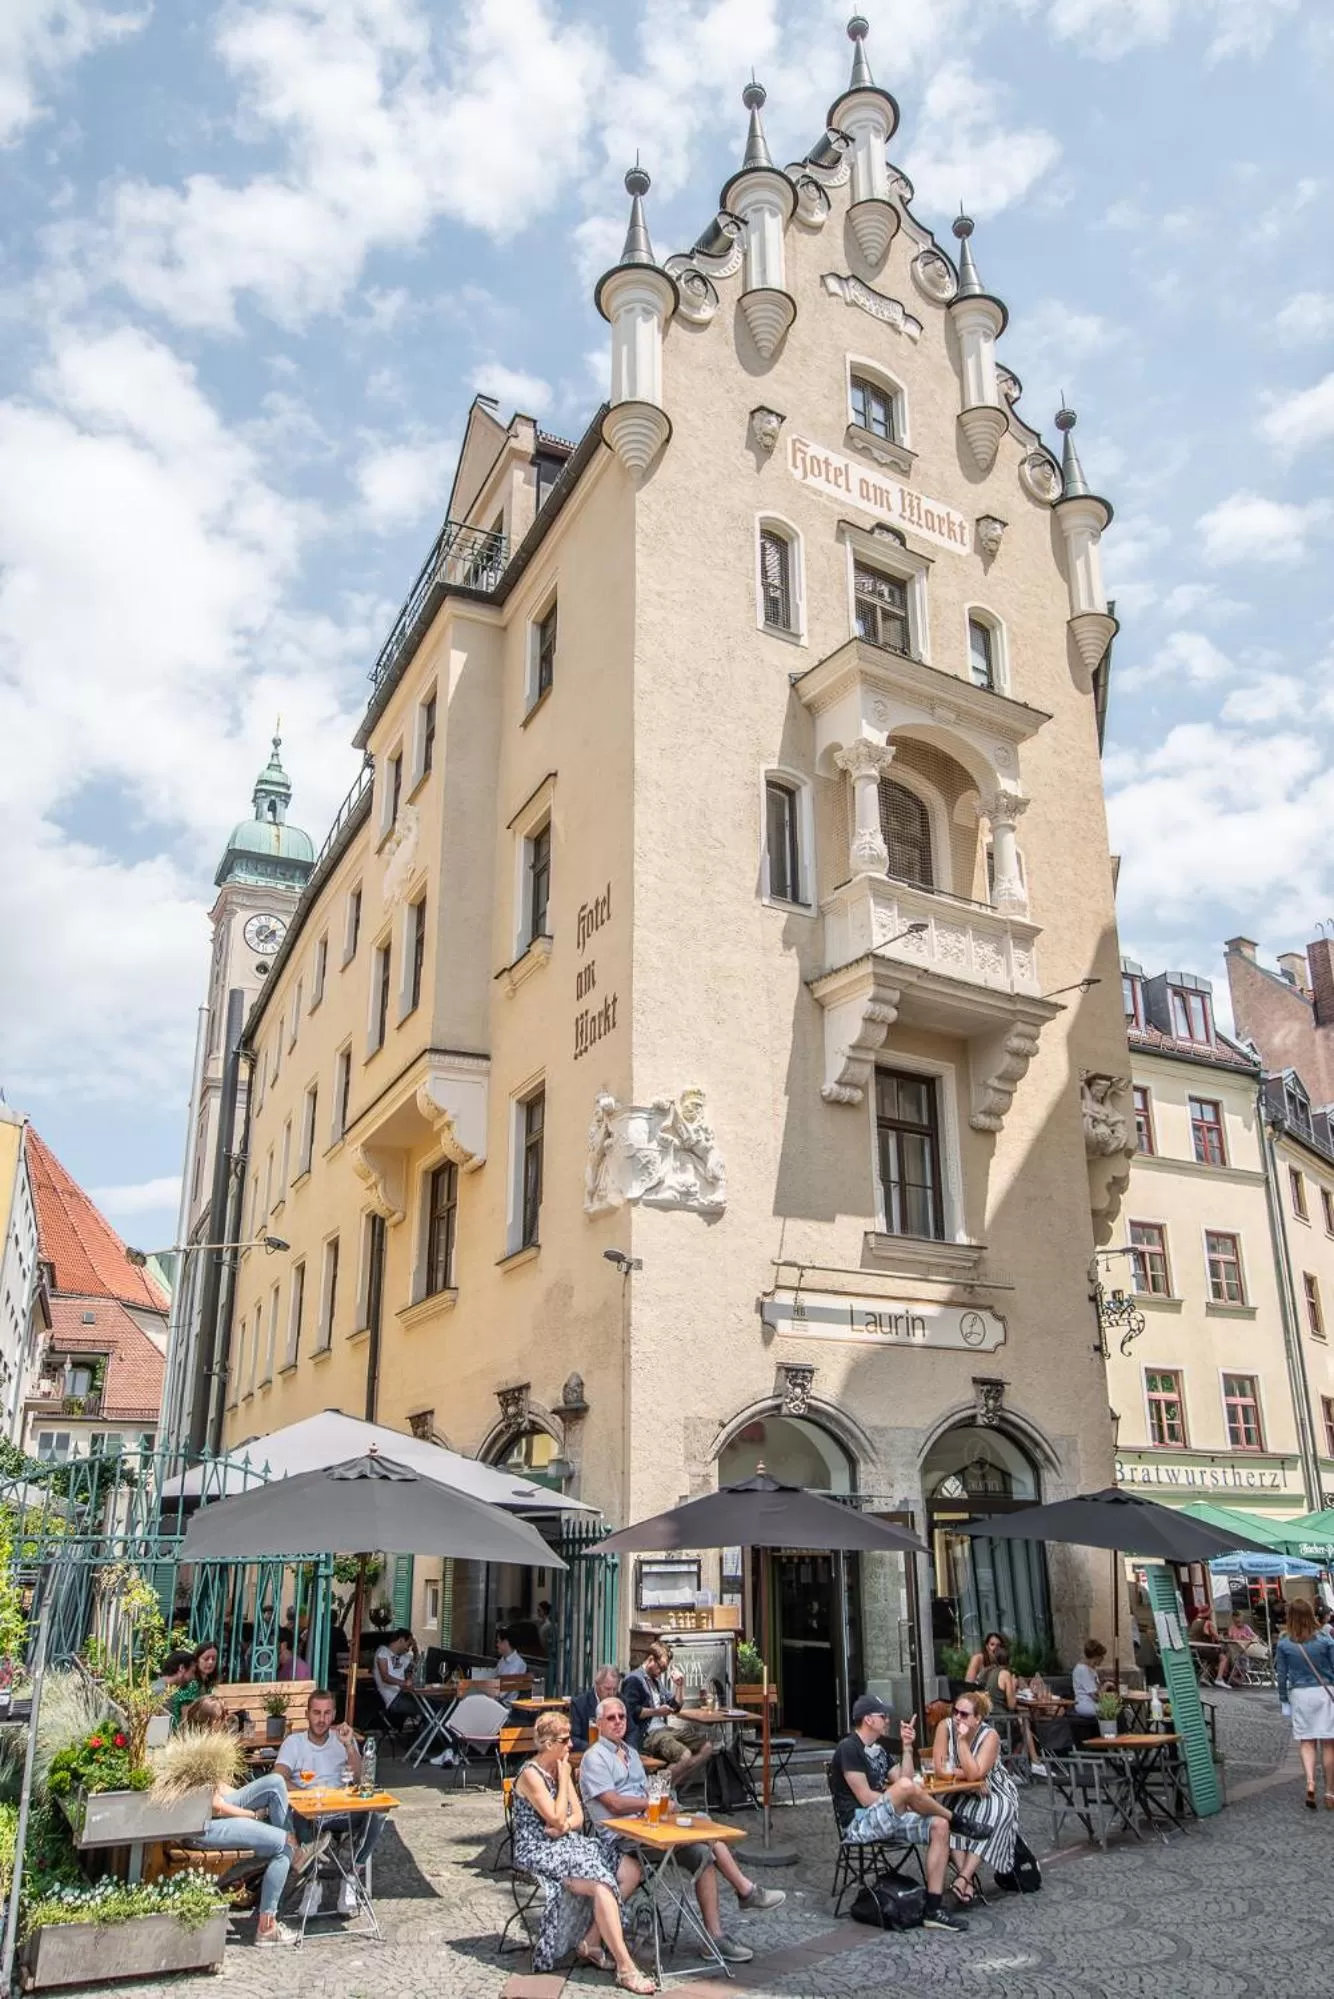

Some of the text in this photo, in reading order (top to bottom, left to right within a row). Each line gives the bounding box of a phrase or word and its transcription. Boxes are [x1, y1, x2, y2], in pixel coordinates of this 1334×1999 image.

[792, 437, 968, 546] Hotel am Markt
[577, 881, 611, 956] Hotel
[576, 960, 596, 1001] am
[574, 992, 618, 1060] Markt
[850, 1305, 926, 1337] Laurin
[1115, 1460, 1287, 1488] Bratwurstherzl
